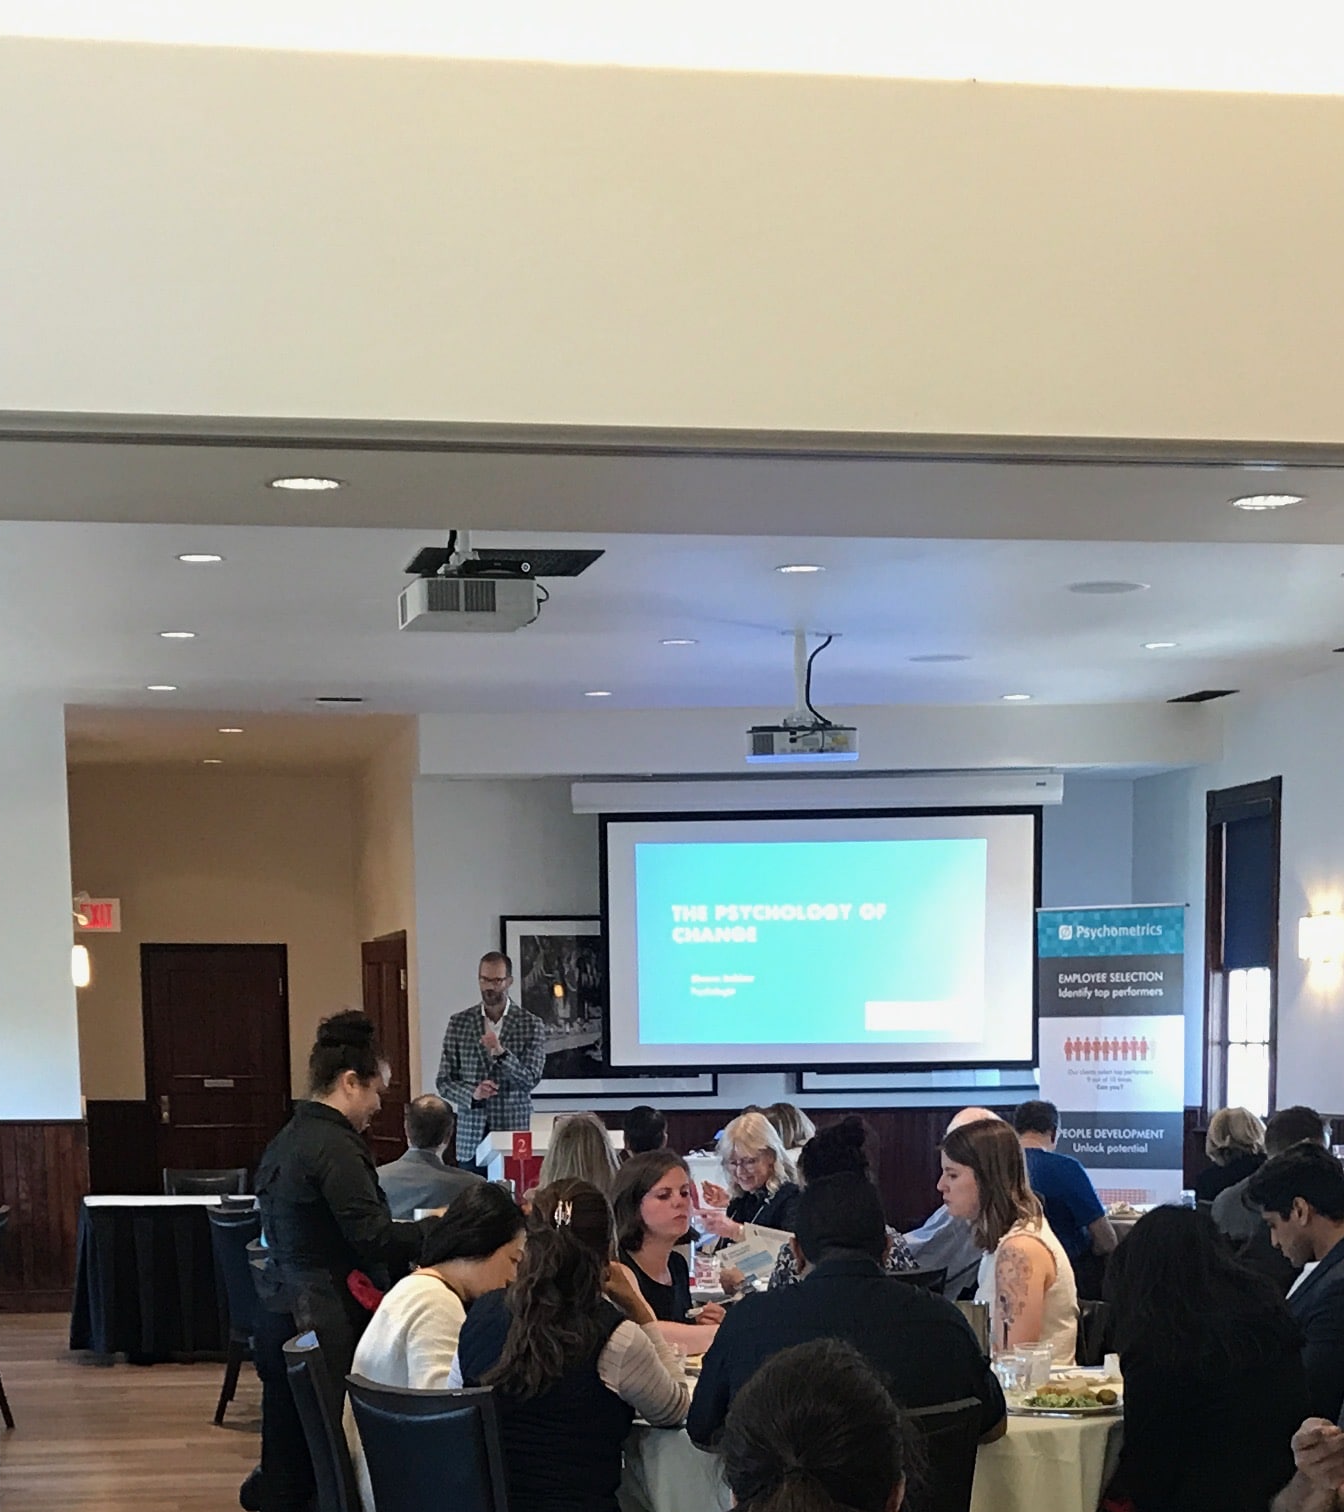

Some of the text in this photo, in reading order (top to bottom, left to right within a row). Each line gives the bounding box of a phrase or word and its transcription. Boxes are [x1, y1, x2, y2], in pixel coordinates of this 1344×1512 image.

[80, 903, 113, 928] EXIT
[672, 903, 887, 922] THE PSYCHOLOGY OF
[672, 926, 758, 943] CHANGE
[1076, 923, 1163, 940] Psychometrics
[1058, 971, 1164, 984] EMPLOYEE SELECTION
[1058, 986, 1164, 999] Identify top performers
[1094, 1128, 1165, 1139] DEVELOPMENT
[518, 1139, 527, 1153] 2
[1073, 1142, 1149, 1155] Unlock potential
